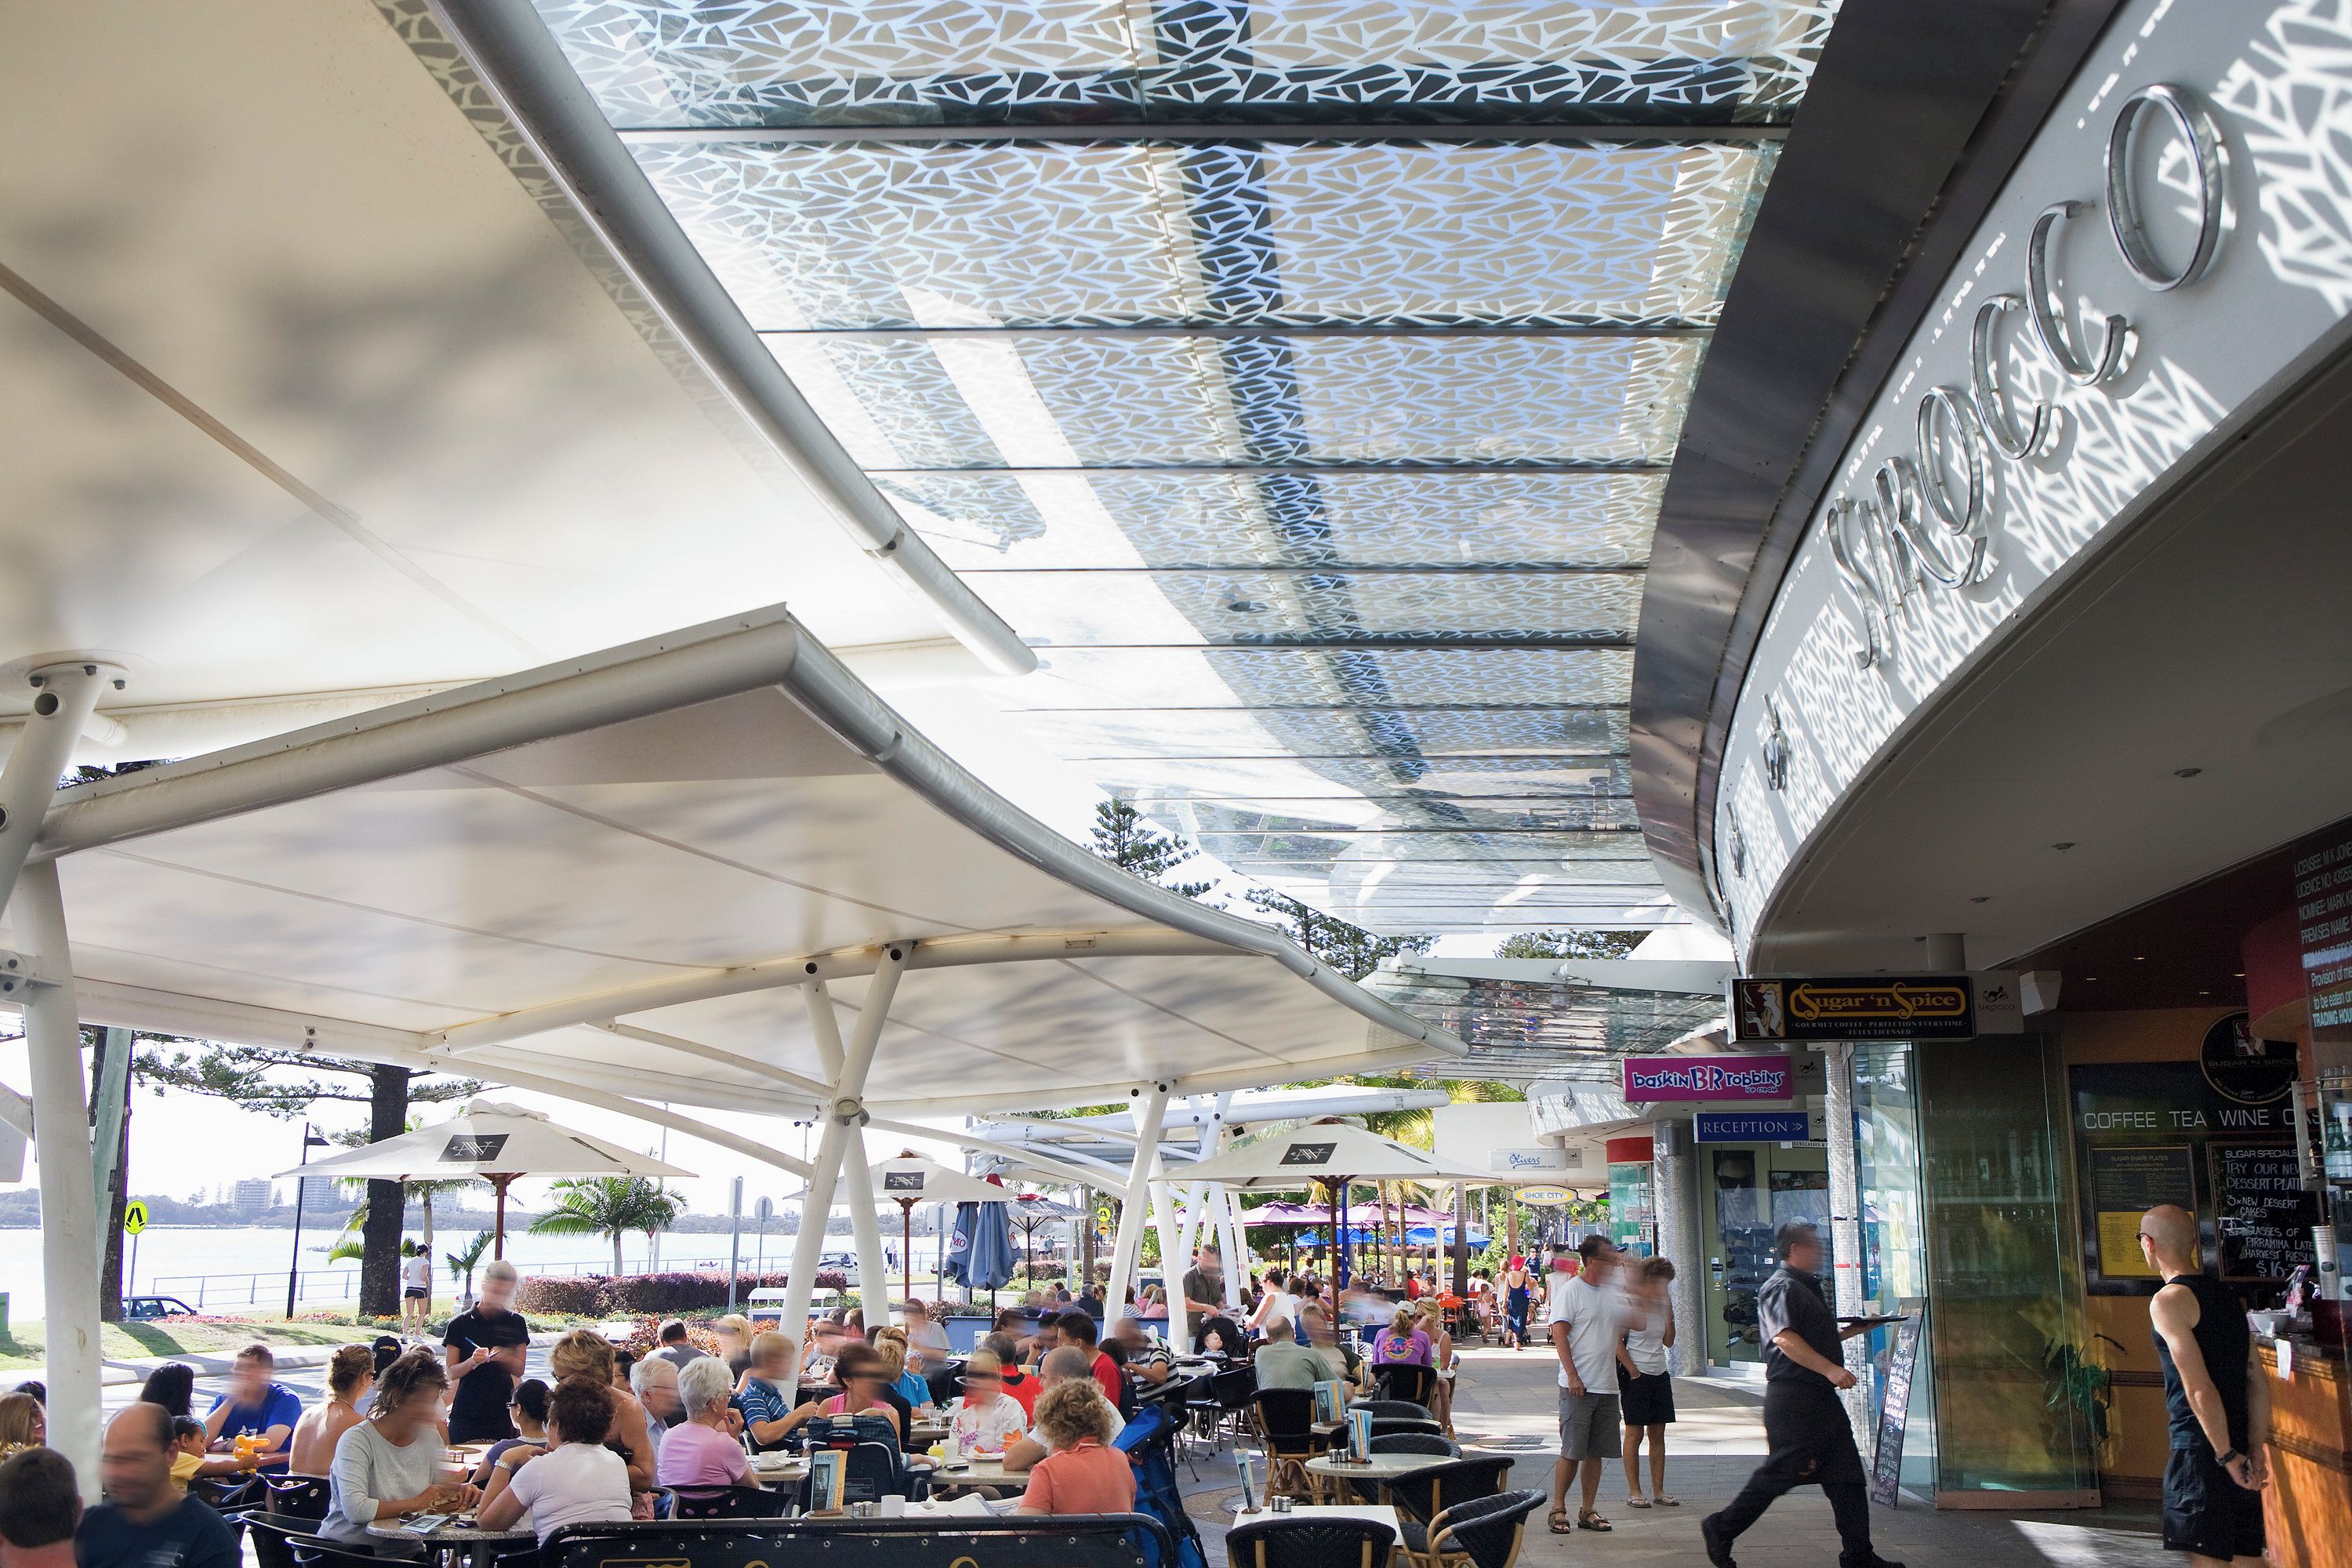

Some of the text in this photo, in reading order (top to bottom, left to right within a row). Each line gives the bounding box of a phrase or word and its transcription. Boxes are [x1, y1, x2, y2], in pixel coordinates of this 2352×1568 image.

[1827, 82, 2224, 670] SIROCCO
[2301, 922, 2330, 945] PREMISES
[2311, 969, 2336, 987] Provision
[1798, 982, 1864, 1021] Sugar
[1892, 982, 1955, 1019] Spice
[2313, 1010, 2339, 1027] TRADING
[1689, 1065, 1726, 1091] BR
[1745, 1085, 1755, 1094] ice
[2084, 1112, 2157, 1129] COFFEE
[2168, 1110, 2208, 1127] TEA
[2218, 1109, 2270, 1126] WINE
[1703, 1121, 1788, 1134] RECEPTION
[1509, 1152, 1541, 1167] Olivers
[2225, 1150, 2256, 1159] SUGAR
[2254, 1163, 2278, 1174] OUR
[2227, 1177, 2272, 1190] DESSERT
[2263, 1197, 2300, 1210] DESSERT
[2240, 1207, 2267, 1218] CAKES
[2247, 1225, 2282, 1237] GLASSES
[2285, 1228, 2300, 1237] OF
[2294, 1240, 2314, 1250] LATE
[2245, 1248, 2281, 1260] HARVEST
